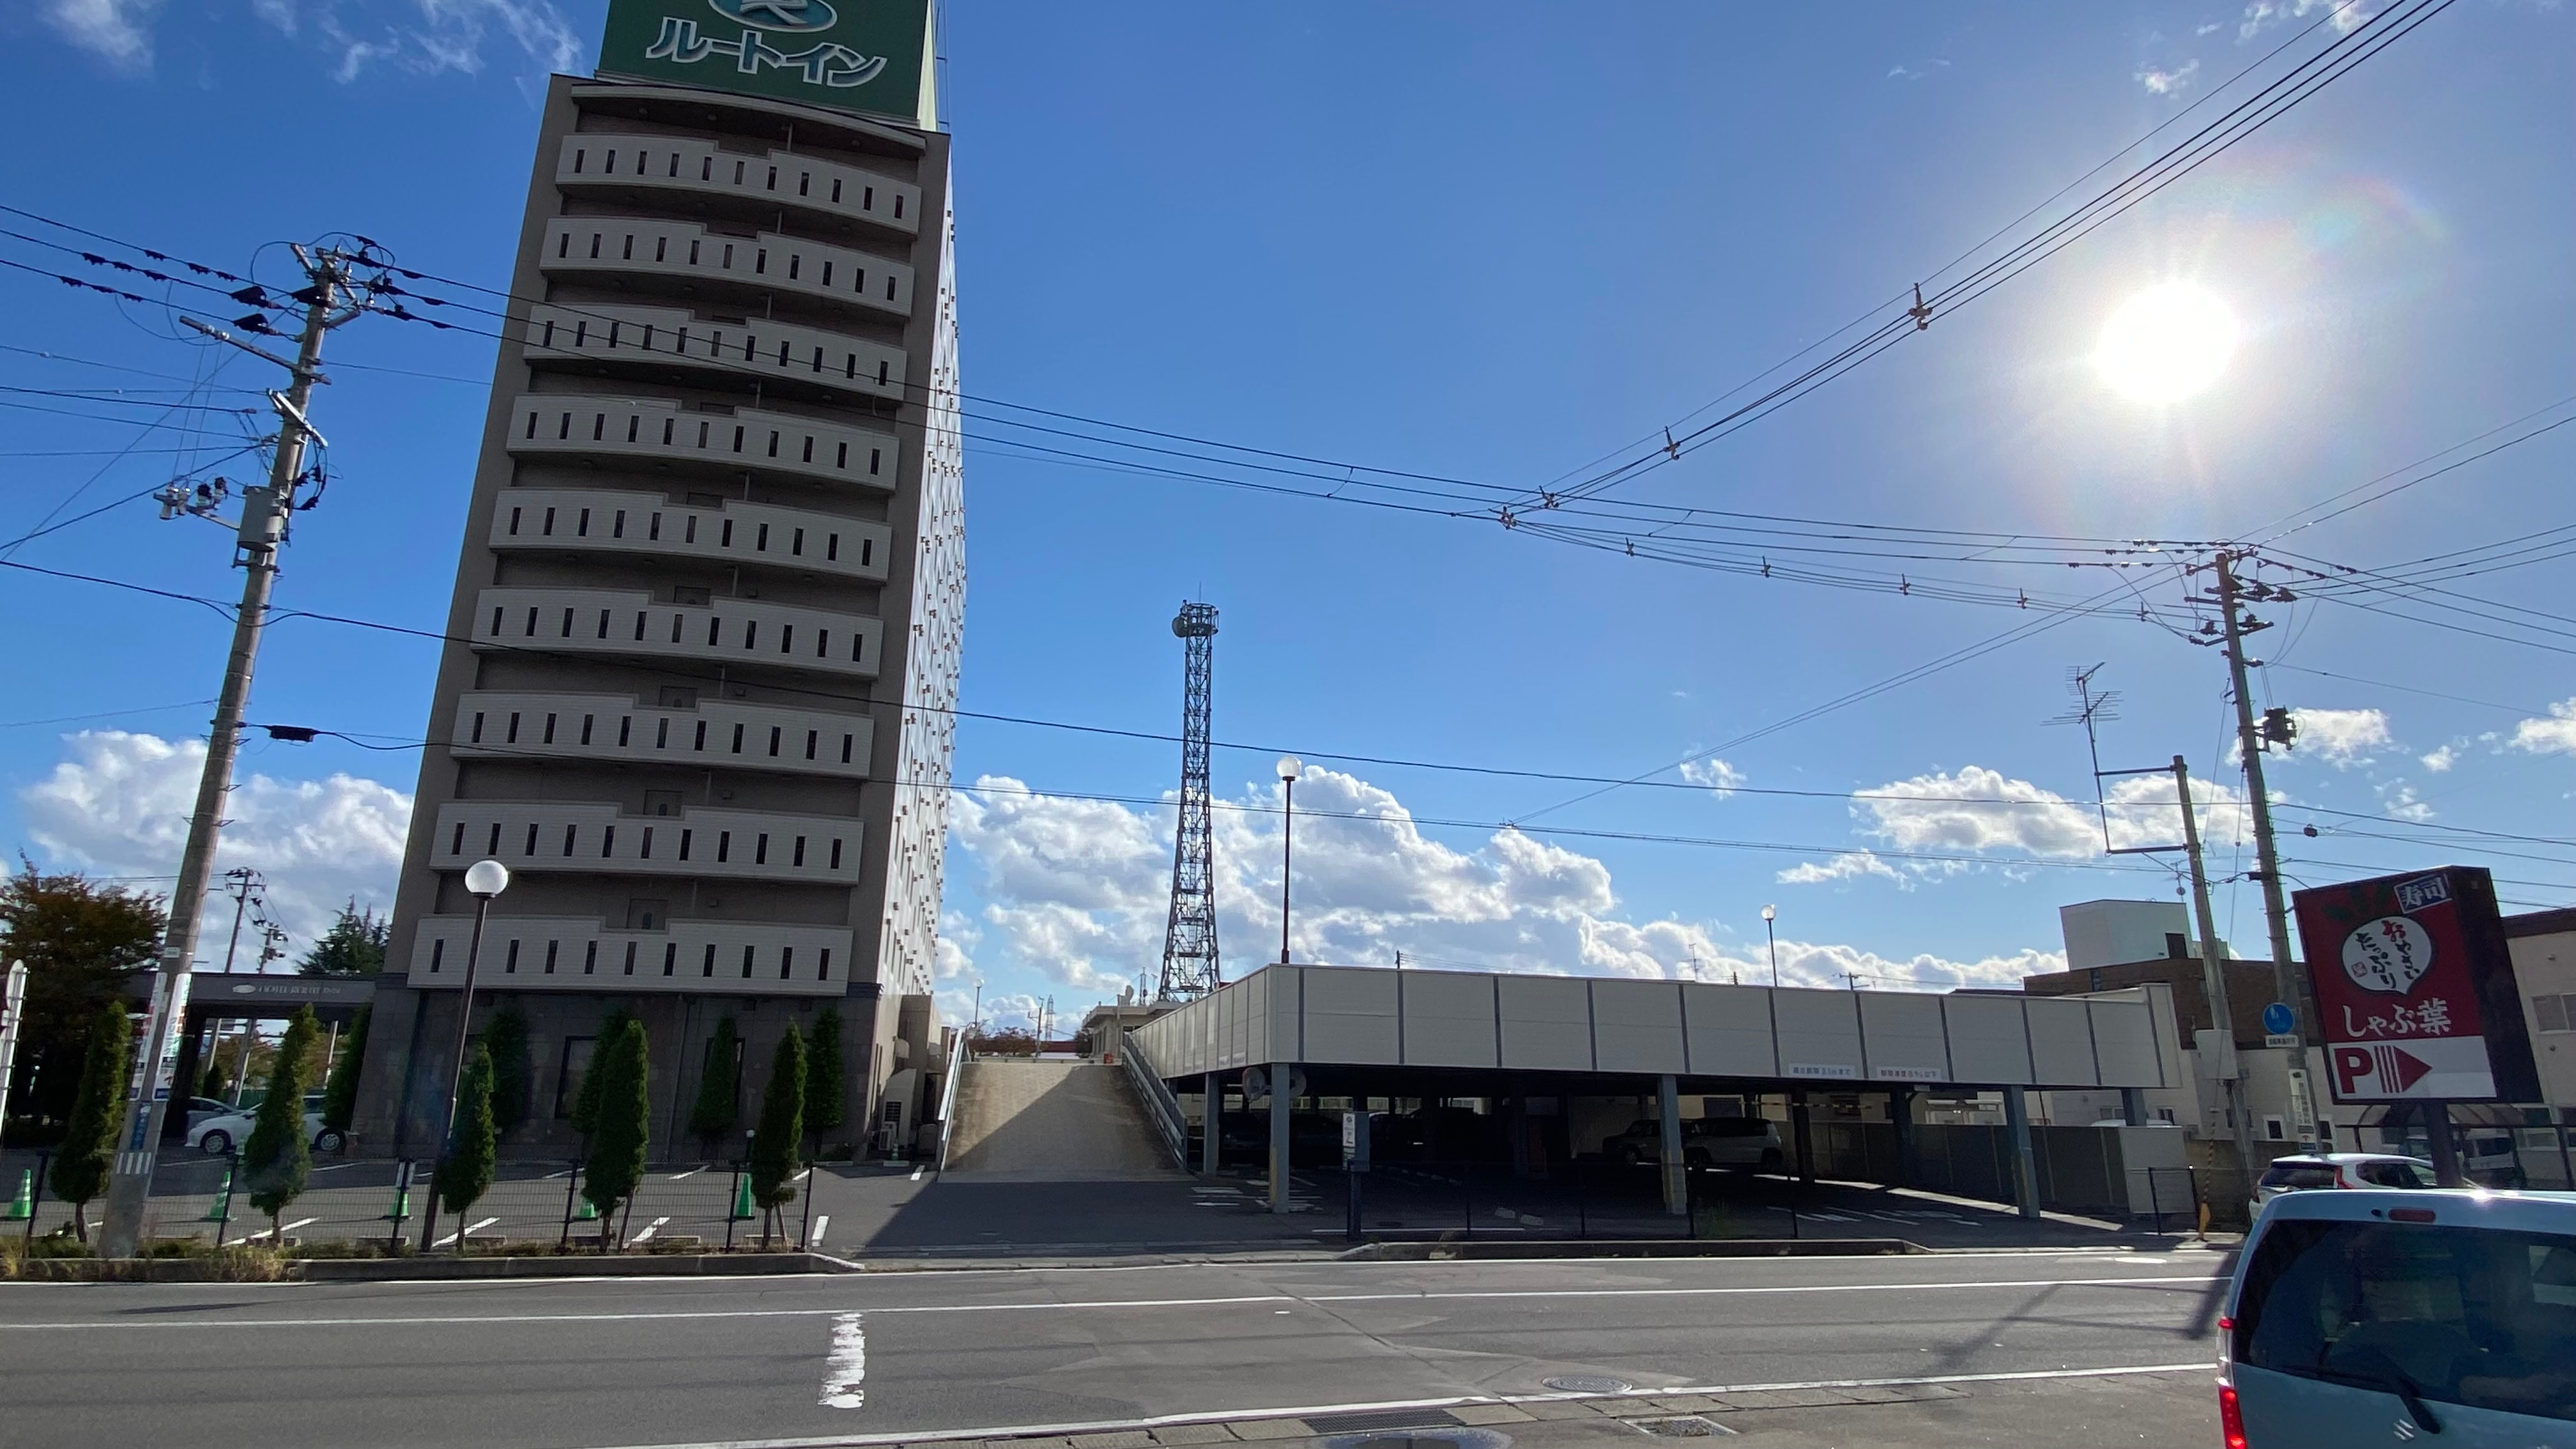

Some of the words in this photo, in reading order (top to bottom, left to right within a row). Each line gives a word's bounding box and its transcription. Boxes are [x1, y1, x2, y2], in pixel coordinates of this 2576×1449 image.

[645, 16, 888, 88] ルートイン
[2400, 876, 2447, 908] 寿司
[2342, 997, 2452, 1037] しゃぶ葉
[2334, 1046, 2373, 1094] P
